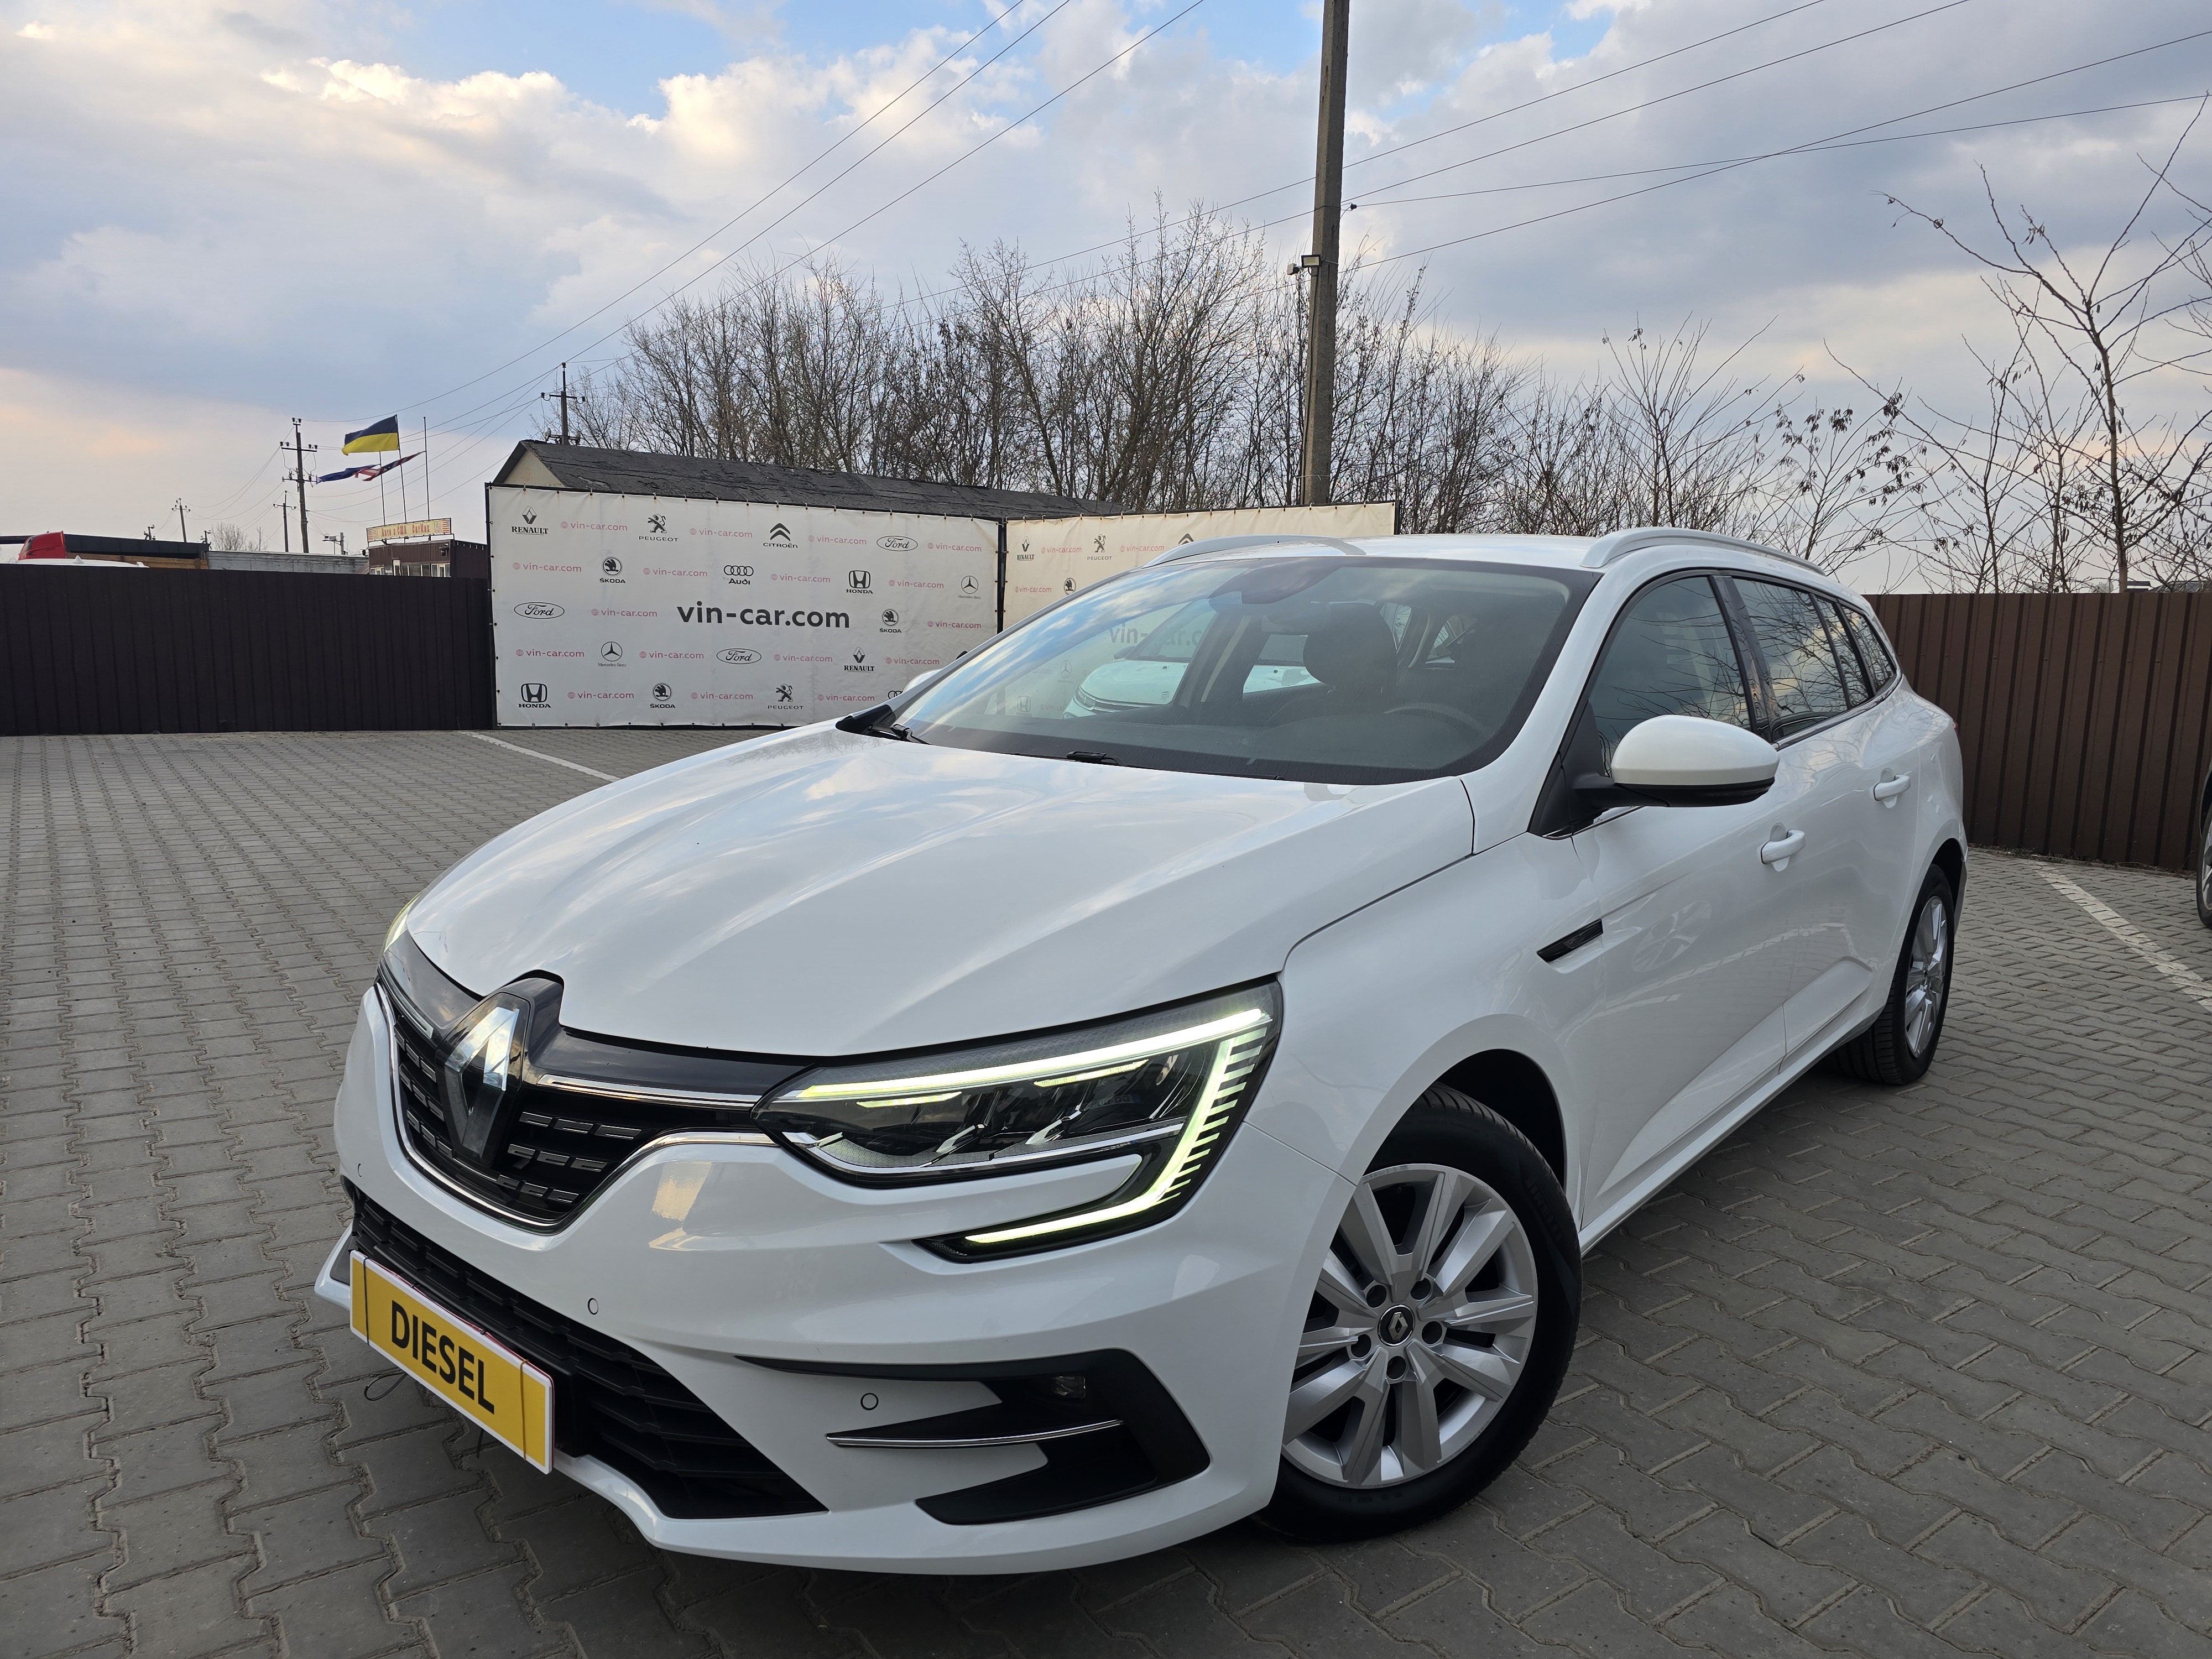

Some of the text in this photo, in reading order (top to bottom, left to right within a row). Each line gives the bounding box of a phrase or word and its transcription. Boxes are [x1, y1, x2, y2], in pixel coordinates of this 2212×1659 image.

[397, 525, 407, 535] США
[512, 526, 548, 534] RENAULT
[571, 522, 628, 532] vin-car.com
[699, 528, 753, 538] vin-car.com
[817, 535, 867, 545] vin-car.com
[885, 539, 909, 549] Ford
[936, 542, 982, 552] vin-car.com
[523, 562, 582, 572] vin-car.com
[653, 568, 708, 577] vin-car.com
[780, 574, 831, 583] vin-car.com
[897, 580, 944, 588] vin-car.com
[525, 604, 554, 617] Ford
[601, 608, 658, 617] vin-car.com
[677, 601, 849, 628] vin-car.com
[936, 620, 982, 629] vin-car.com
[526, 648, 585, 658] vin-car.com
[649, 651, 704, 660] vin-car.com
[726, 653, 752, 662] Ford
[782, 654, 833, 663] vin-car.com
[894, 657, 940, 666] vin-car.com
[577, 691, 634, 700] vin-car.com
[700, 691, 753, 700] vin-car.com
[826, 693, 875, 702] vin-car.com
[392, 1300, 494, 1415] DIESEL
